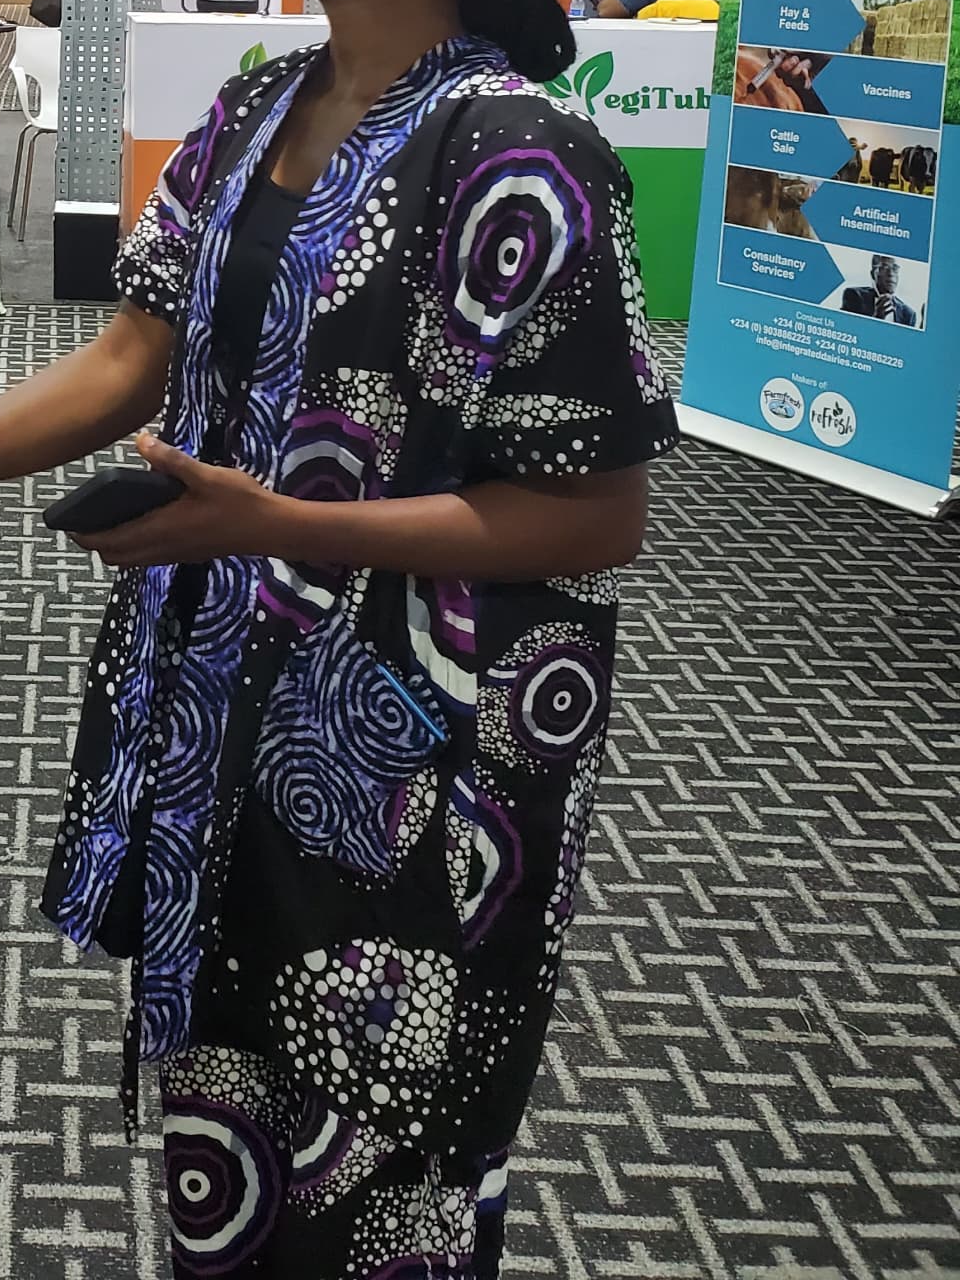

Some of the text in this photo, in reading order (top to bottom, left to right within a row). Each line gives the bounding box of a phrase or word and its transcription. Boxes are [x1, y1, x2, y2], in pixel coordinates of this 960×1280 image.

[779, 6, 810, 20] Hay &
[779, 18, 810, 31] Feeds
[862, 83, 912, 100] Vaccines
[770, 128, 800, 143] Cattle
[772, 141, 796, 155] Sale
[853, 205, 900, 224] Artificial
[840, 215, 911, 239] Insemination
[743, 247, 806, 272] Consultancy
[751, 261, 795, 280] Services
[773, 317, 793, 329] +234
[795, 311, 836, 328] Contact Us
[730, 318, 750, 330] +234
[815, 338, 836, 352] +234
